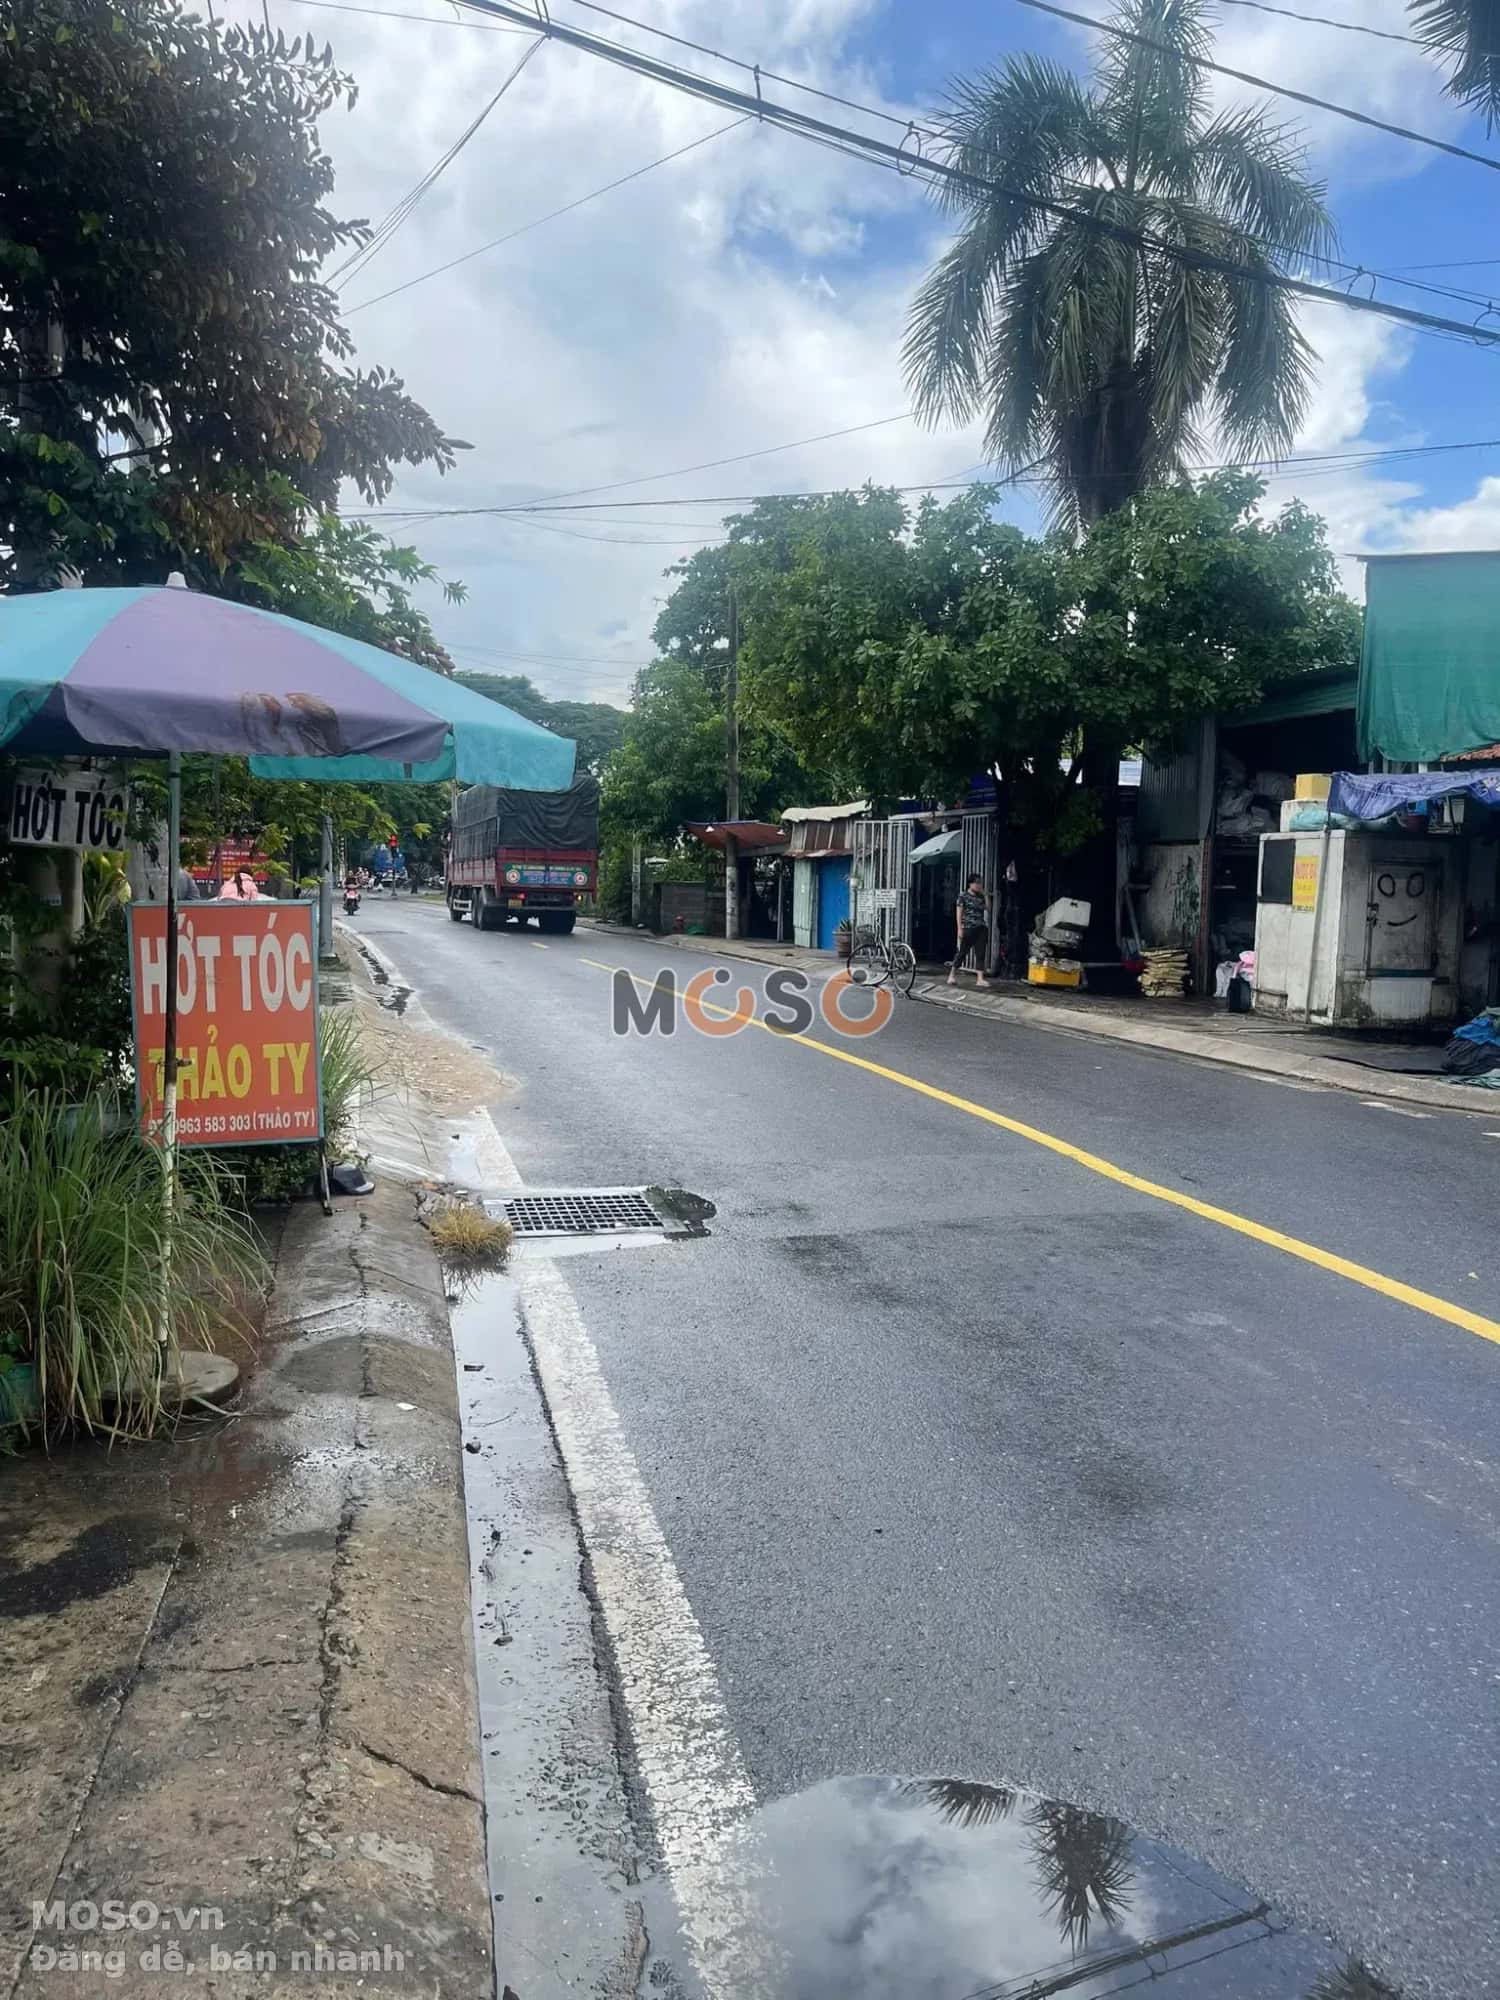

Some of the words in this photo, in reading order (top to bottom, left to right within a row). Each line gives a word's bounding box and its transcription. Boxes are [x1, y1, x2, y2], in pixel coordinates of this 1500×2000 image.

[13, 772, 66, 841] HỚT
[75, 778, 123, 848] TÓC
[140, 912, 221, 1015] HỚT
[233, 912, 312, 1012] TÓC
[148, 1024, 252, 1101] THẢO
[262, 1042, 311, 1096] TY
[205, 1116, 226, 1132] 583
[230, 1113, 251, 1131] 303
[252, 1106, 291, 1131] (THẢO
[295, 1107, 315, 1128] TY)
